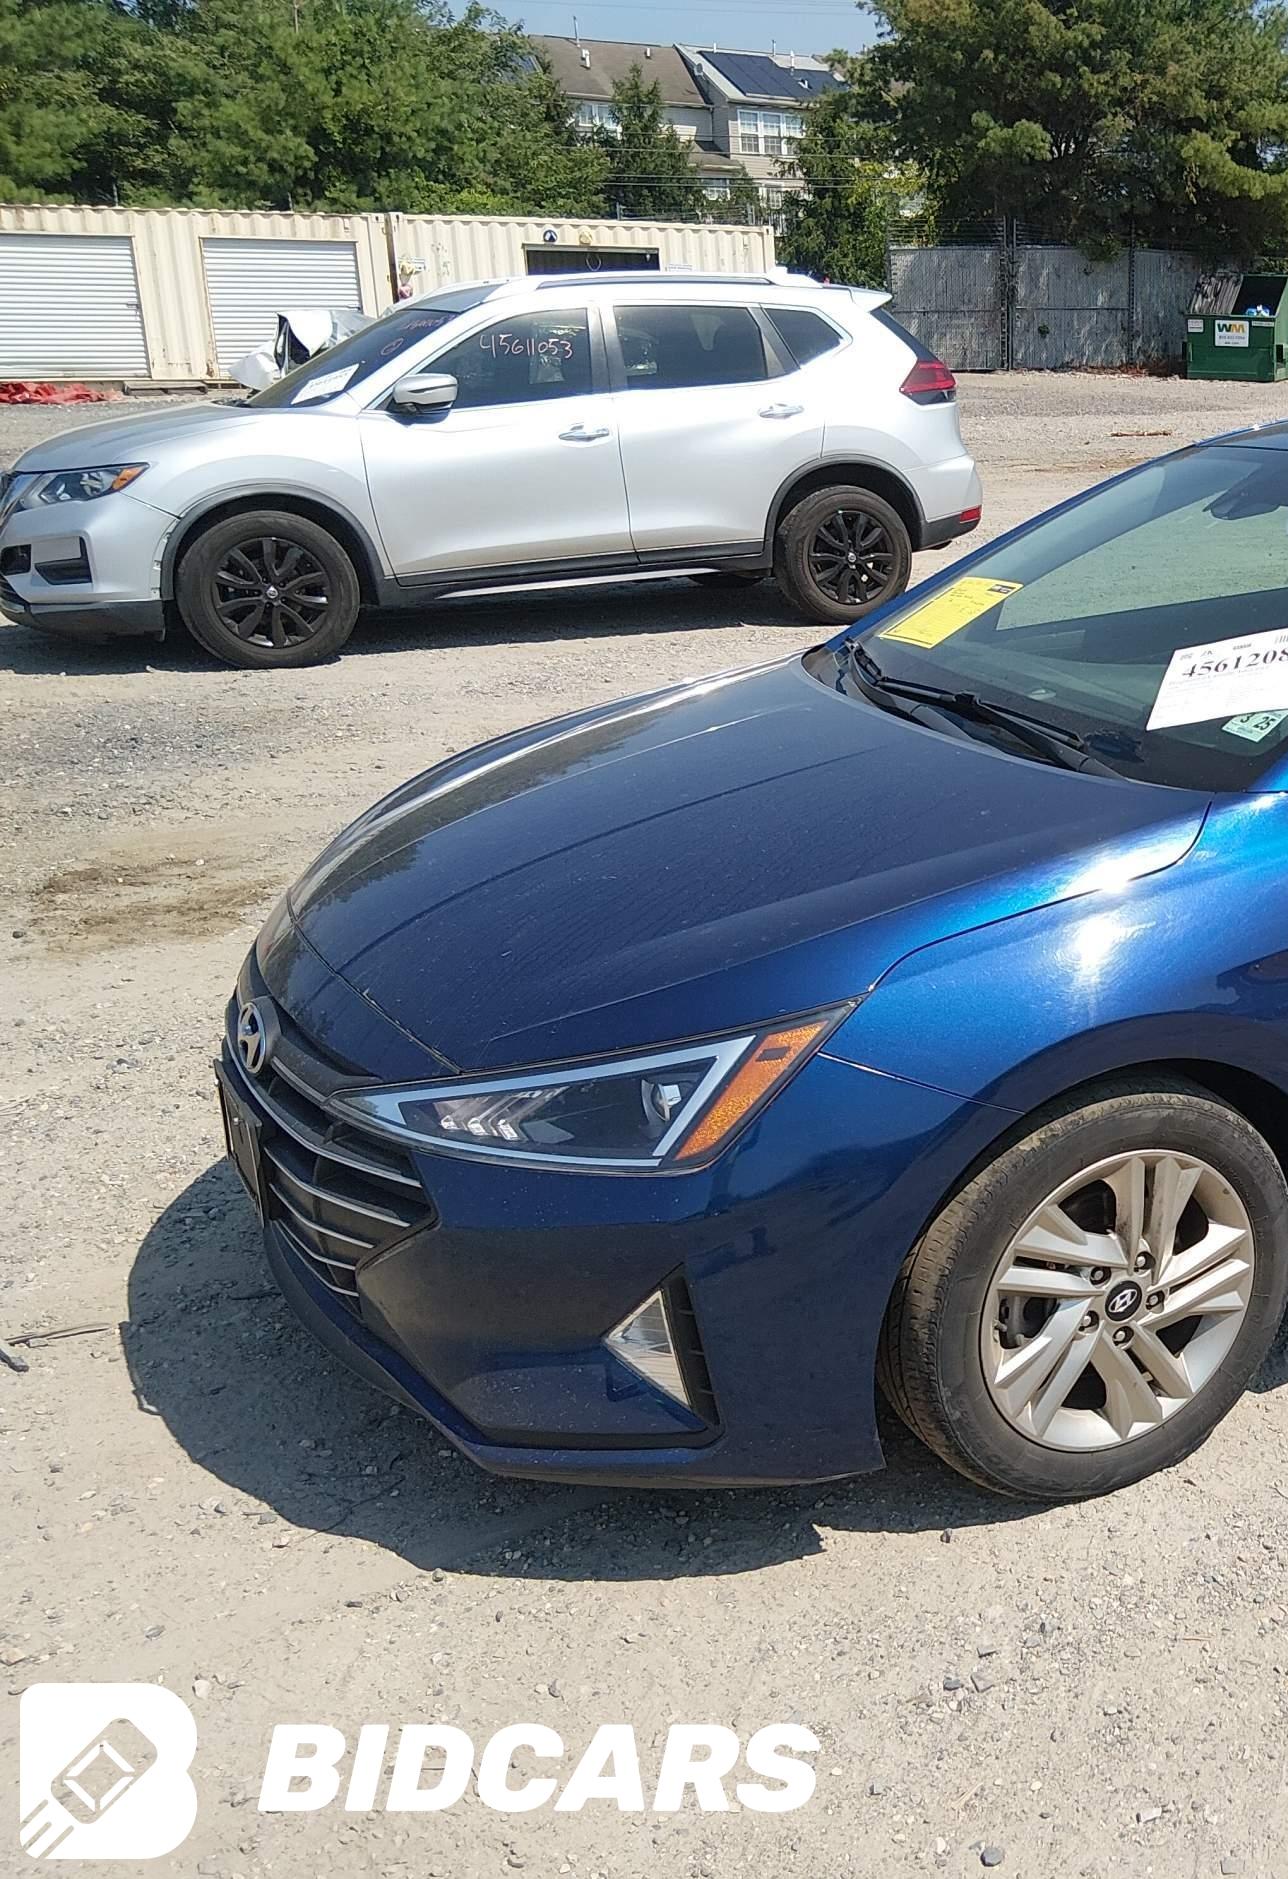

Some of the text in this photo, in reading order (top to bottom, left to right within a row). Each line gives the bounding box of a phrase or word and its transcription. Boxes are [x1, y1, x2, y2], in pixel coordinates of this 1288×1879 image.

[1217, 323, 1245, 333] WM
[479, 333, 573, 358] 45611053
[1252, 715, 1277, 731] 25
